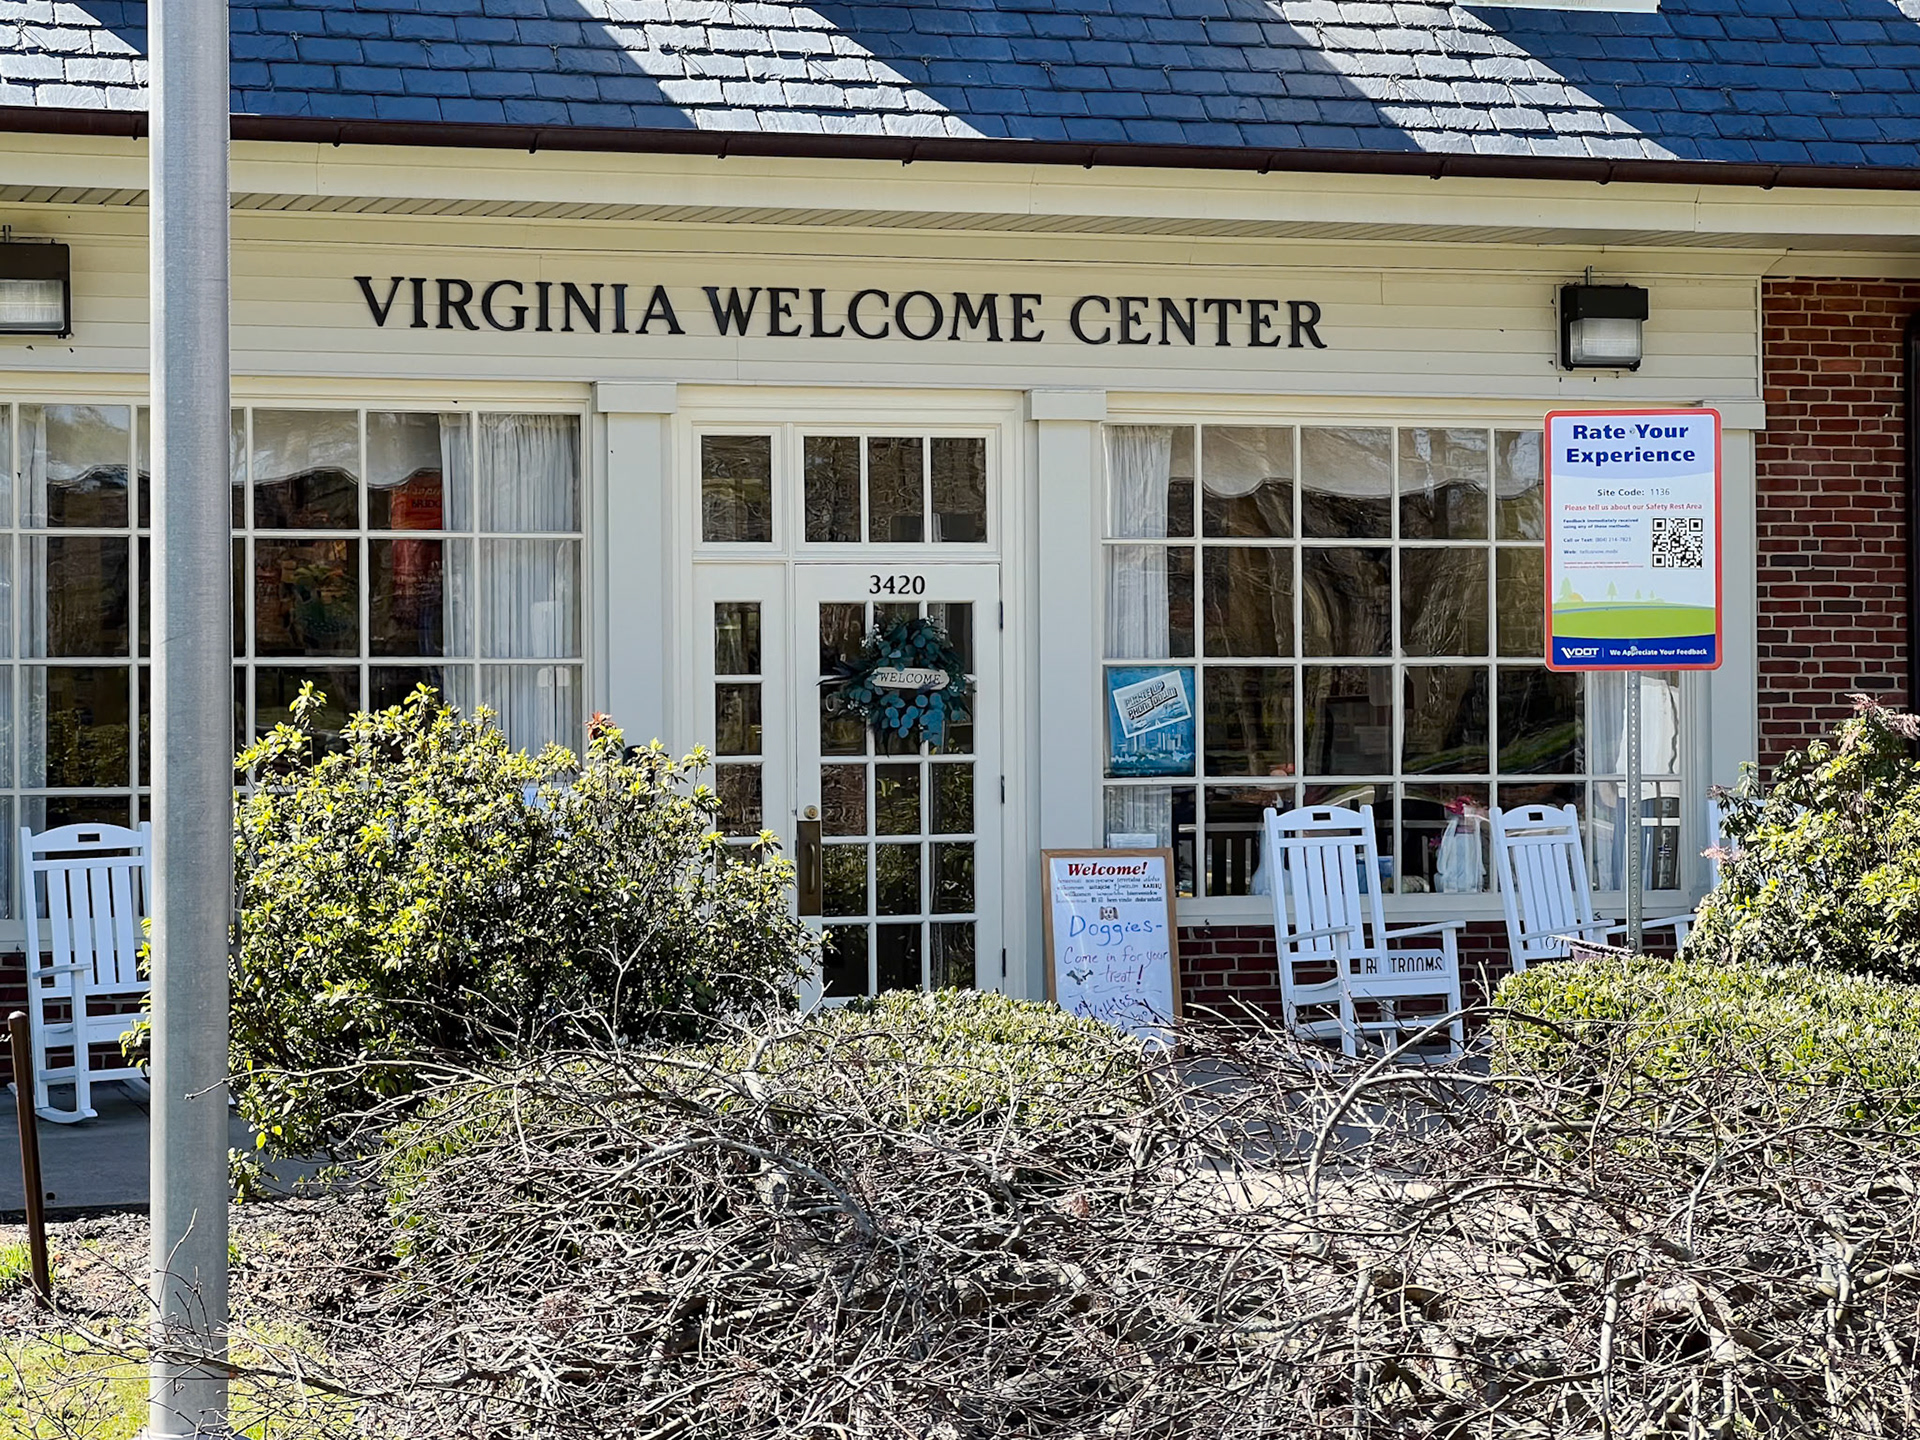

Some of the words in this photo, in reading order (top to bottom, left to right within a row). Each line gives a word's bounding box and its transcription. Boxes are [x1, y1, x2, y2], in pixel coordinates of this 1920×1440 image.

[354, 276, 686, 334] VIRGINIA
[702, 286, 1045, 341] WELCOME
[1070, 295, 1327, 349] CENTER
[1573, 424, 1626, 440] Rate
[1635, 424, 1689, 439] Your
[1566, 446, 1696, 467] Experience
[1597, 489, 1615, 497] Site
[1618, 489, 1645, 497] Code:
[1650, 488, 1670, 496] 1136
[1646, 503, 1668, 512] Safety
[869, 574, 926, 595] 3420
[1561, 647, 1599, 659] VDOT
[1622, 648, 1658, 657] Appreciate
[1659, 648, 1675, 656] Your
[1676, 648, 1707, 656] Feedback
[879, 672, 941, 685] WELCOME
[1068, 861, 1148, 876] Welcome!
[1063, 946, 1099, 965] Come
[1106, 952, 1116, 962] in
[1122, 945, 1143, 962] for
[1146, 950, 1168, 970] your
